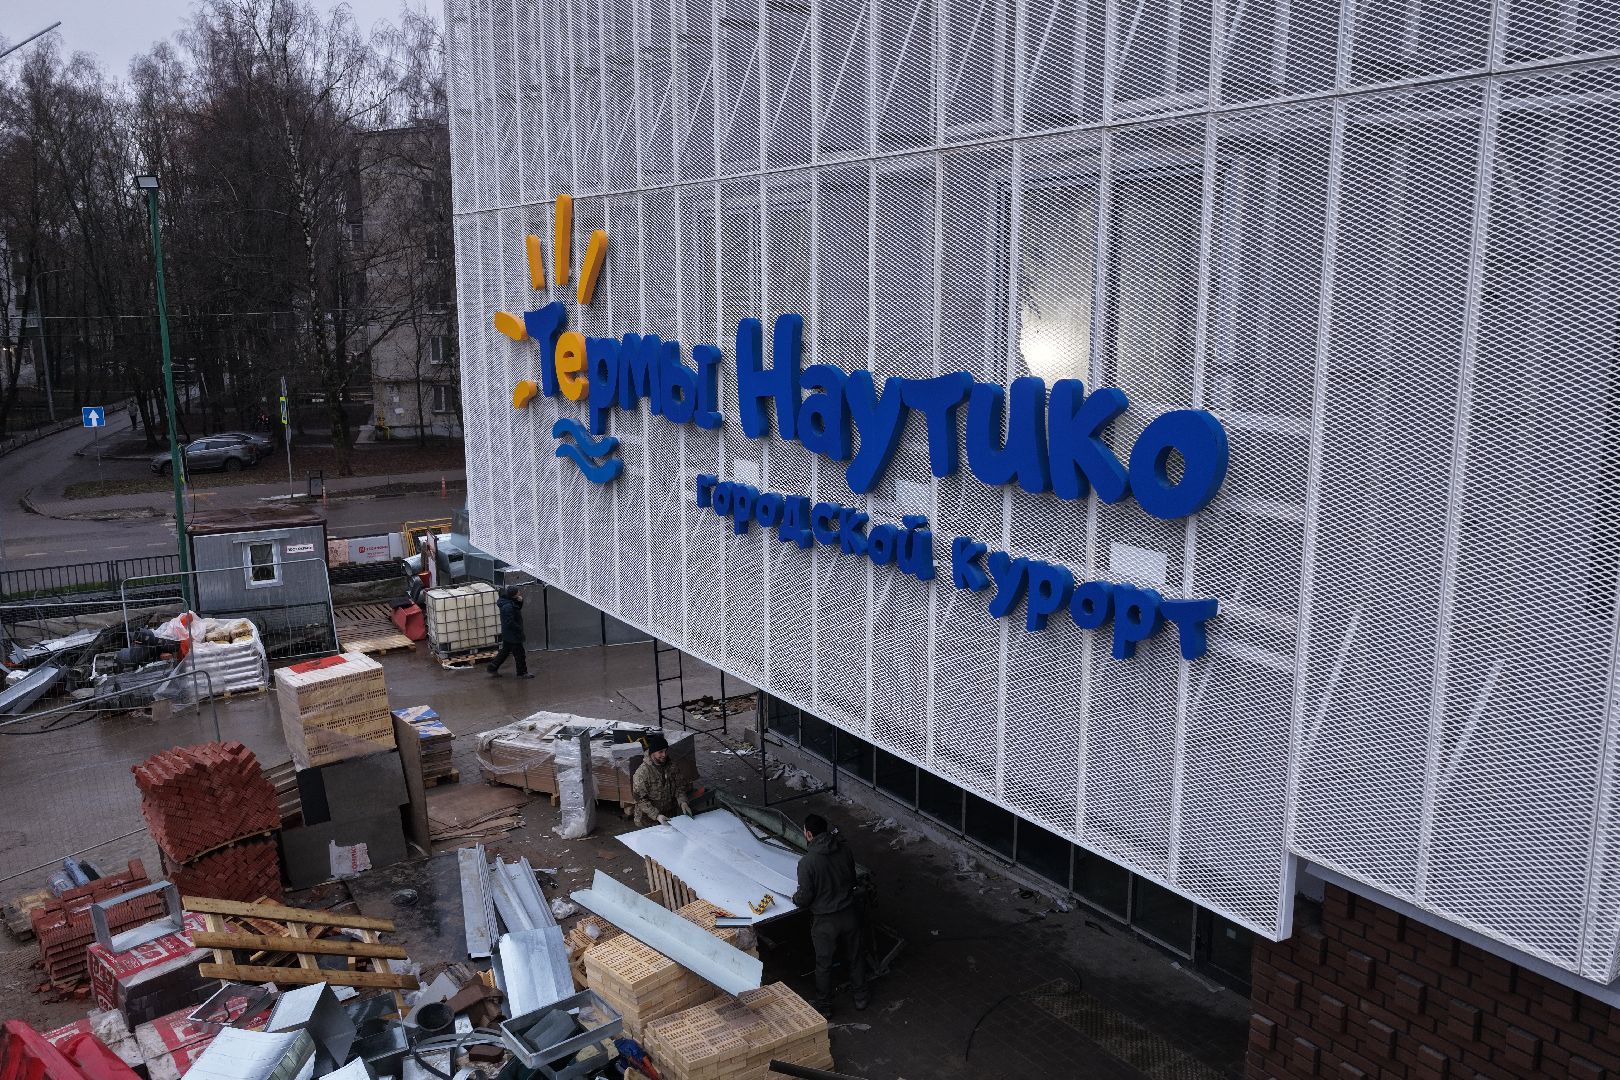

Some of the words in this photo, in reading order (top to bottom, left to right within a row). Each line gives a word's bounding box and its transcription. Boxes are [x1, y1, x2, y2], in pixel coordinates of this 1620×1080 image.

[524, 301, 725, 435] Термы
[736, 313, 1229, 520] Наутико
[696, 474, 935, 581] городской
[952, 536, 1218, 661] курорт
